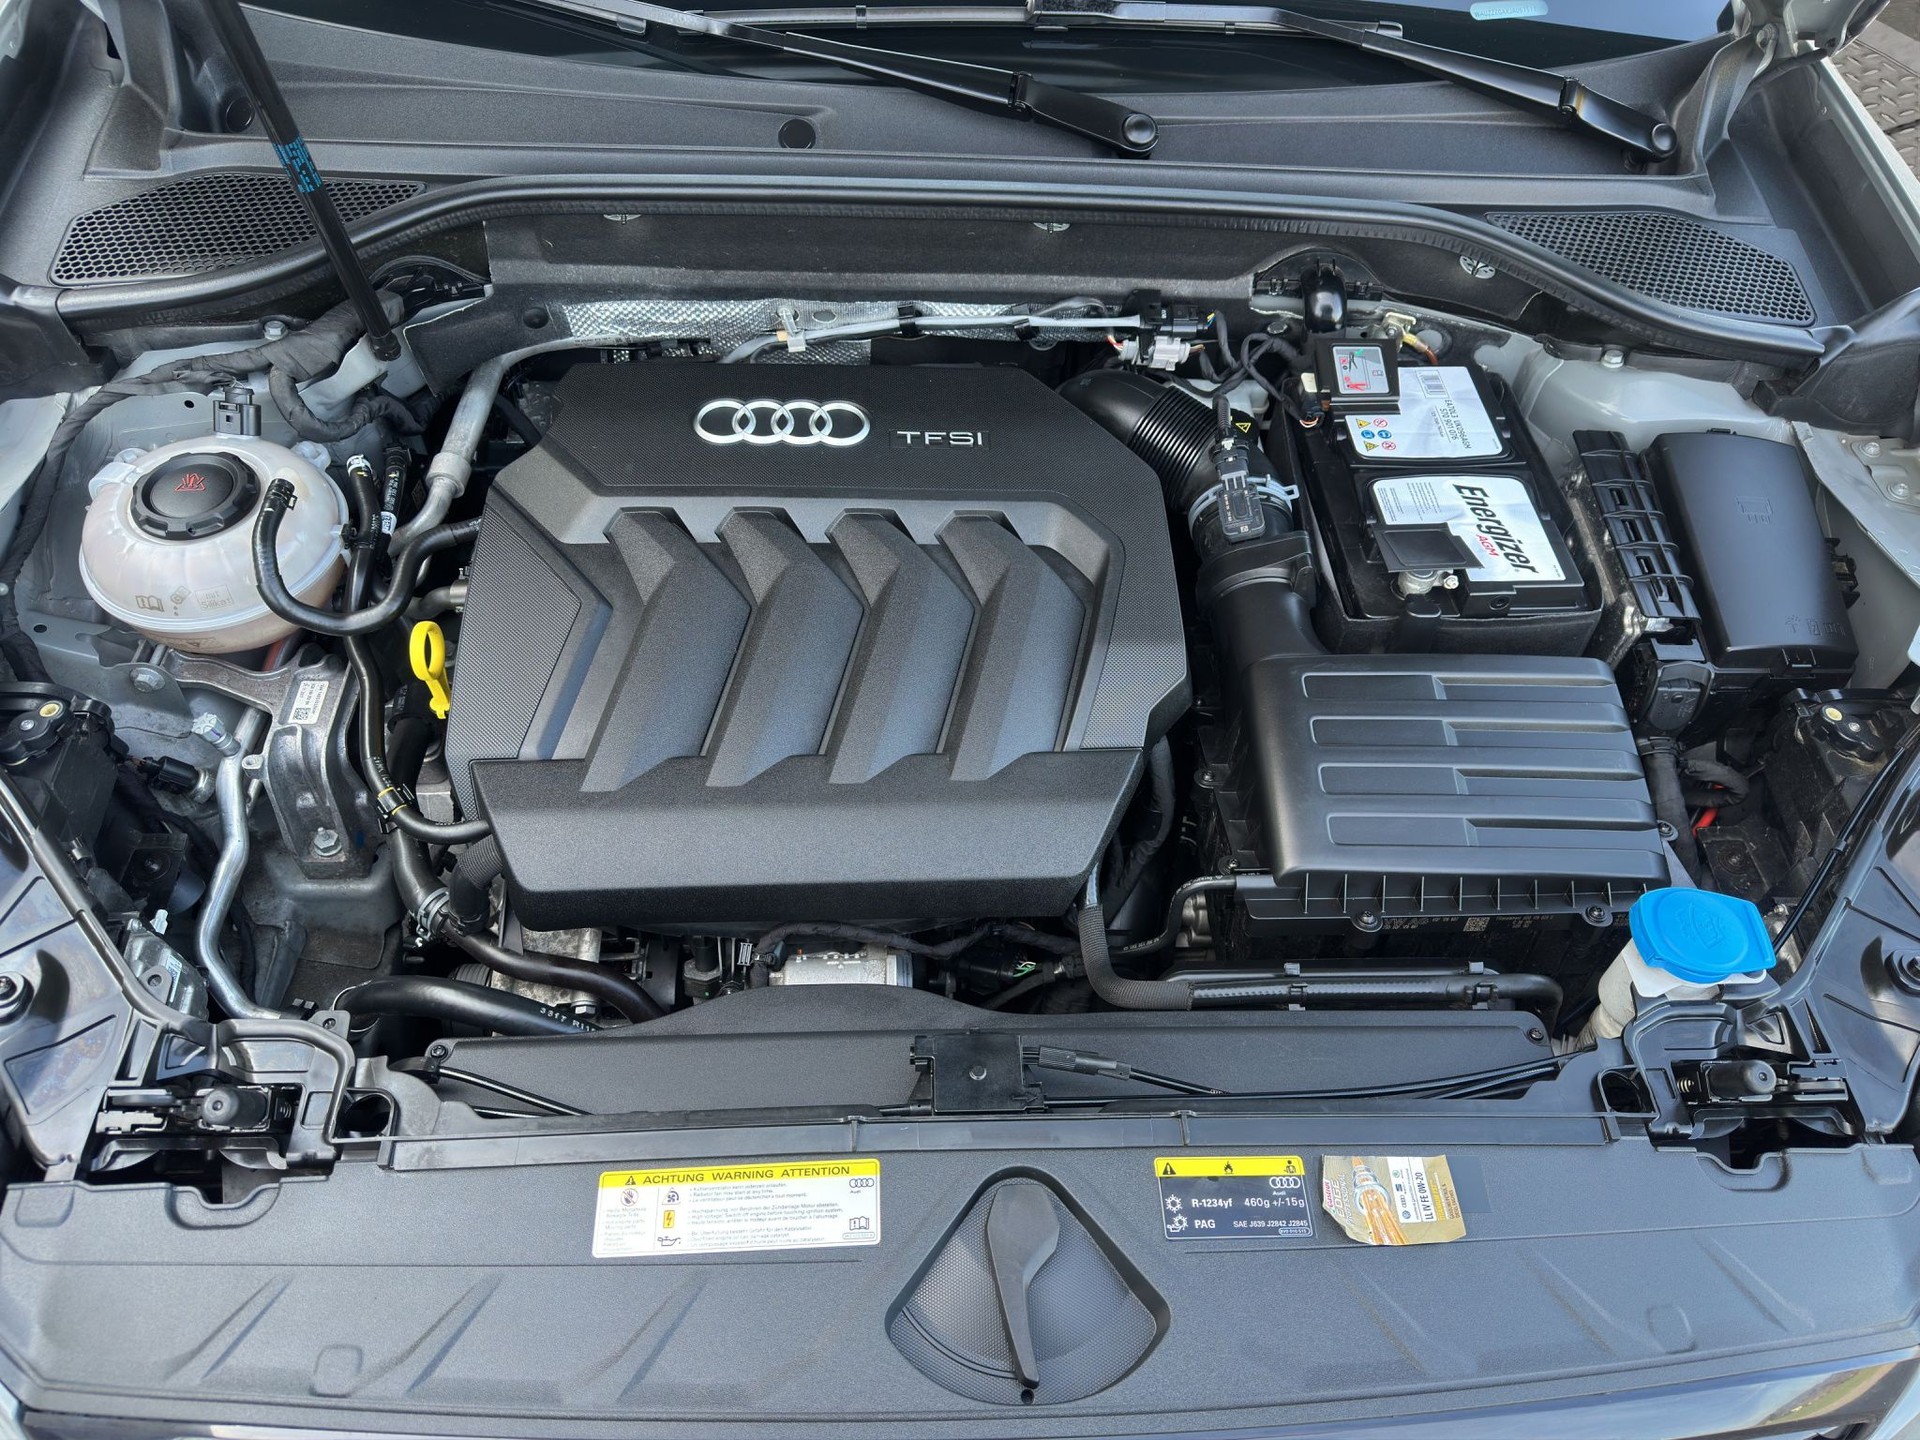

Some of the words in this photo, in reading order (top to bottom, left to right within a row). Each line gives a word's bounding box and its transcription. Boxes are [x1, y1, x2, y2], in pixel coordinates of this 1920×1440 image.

[897, 431, 982, 445] TFSI
[1452, 483, 1540, 574] Energizer
[1476, 534, 1499, 557] AGM
[643, 1173, 704, 1184] ACHTUNG
[711, 1169, 774, 1181] WARNING
[781, 1166, 850, 1178] ATTENTION
[1414, 1172, 1427, 1194] 0W-20
[1191, 1198, 1233, 1209] R-1234yf
[1244, 1197, 1270, 1208] 460g
[1332, 1179, 1346, 1217] EDGE
[1194, 1219, 1216, 1229] PAG
[1233, 1220, 1247, 1228] SAE
[1249, 1220, 1265, 1228] J639
[1288, 1219, 1309, 1227] J2845
